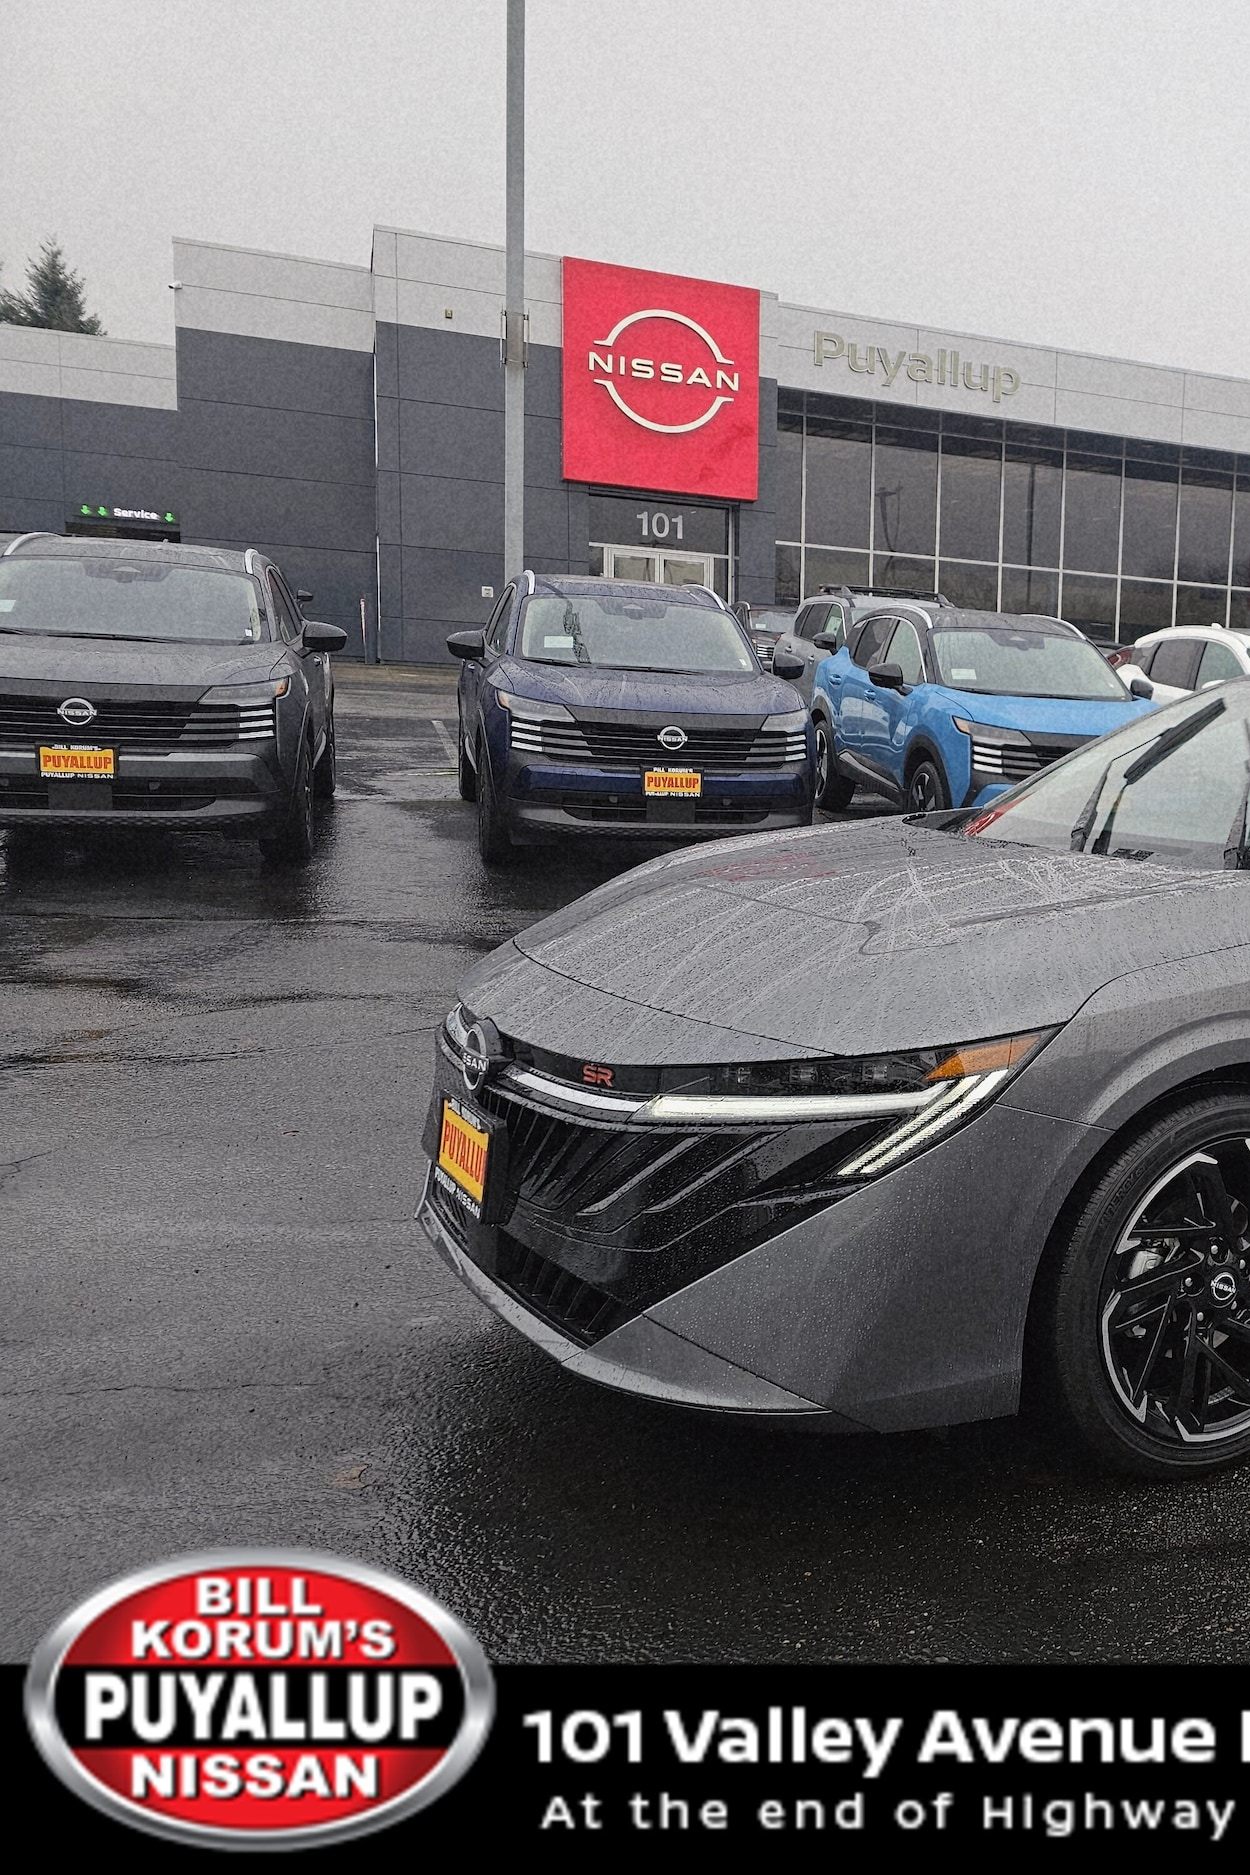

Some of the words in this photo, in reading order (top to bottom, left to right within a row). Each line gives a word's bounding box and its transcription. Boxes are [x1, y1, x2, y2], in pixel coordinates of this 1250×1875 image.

[589, 350, 740, 392] NISSAN
[813, 330, 1022, 403] Puyallup
[113, 507, 160, 521] Service
[636, 511, 684, 540] 101
[57, 708, 97, 716] NISSAN
[43, 755, 111, 769] PUYALLUP
[647, 777, 699, 788] PUYALLUP
[462, 1052, 487, 1072] SSAN
[582, 1064, 614, 1088] SR
[1210, 1279, 1237, 1294] NISSAN
